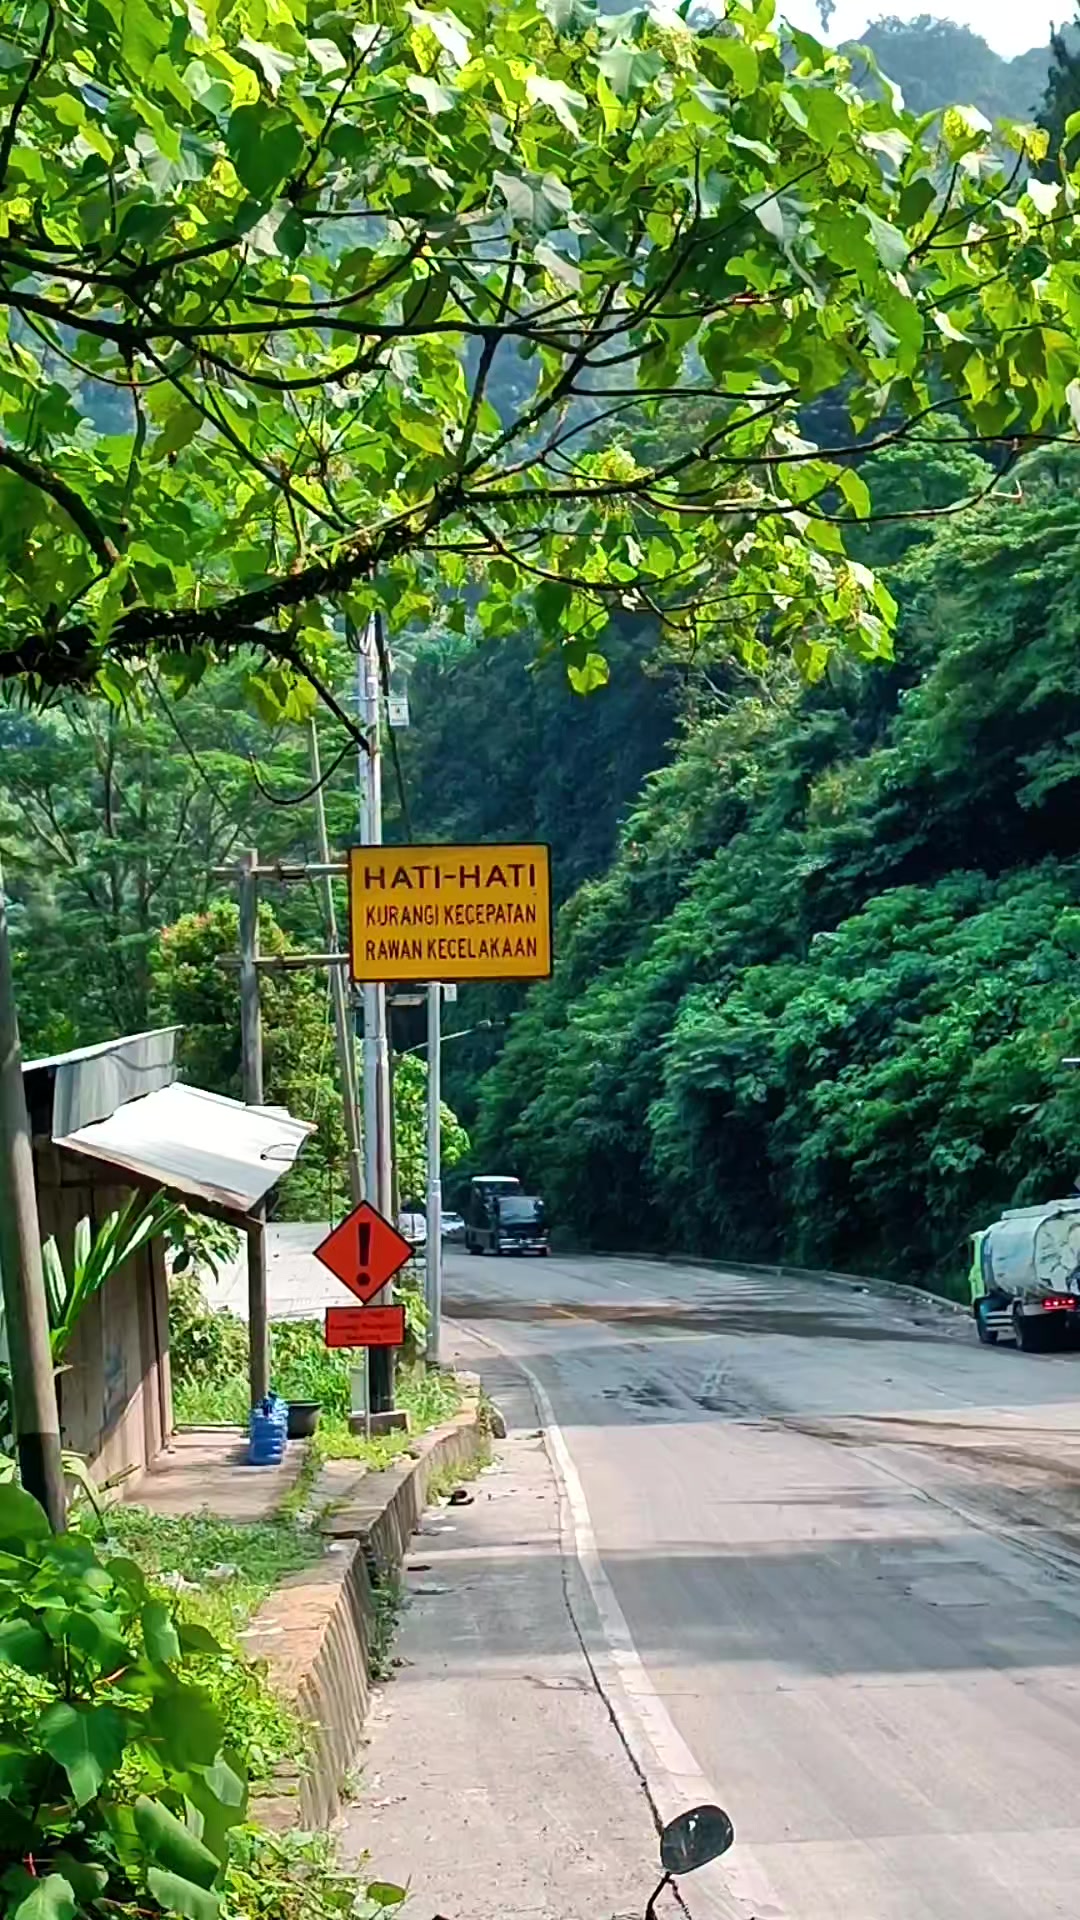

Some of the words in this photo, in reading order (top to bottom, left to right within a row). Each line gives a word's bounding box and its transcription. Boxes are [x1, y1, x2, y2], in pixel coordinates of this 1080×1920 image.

[364, 863, 536, 889] HATI-HATI
[366, 904, 439, 927] KURANGI
[444, 903, 537, 925] KECEPATAN
[366, 939, 422, 961] RAWAN
[427, 937, 537, 960] KECELAKAAN
